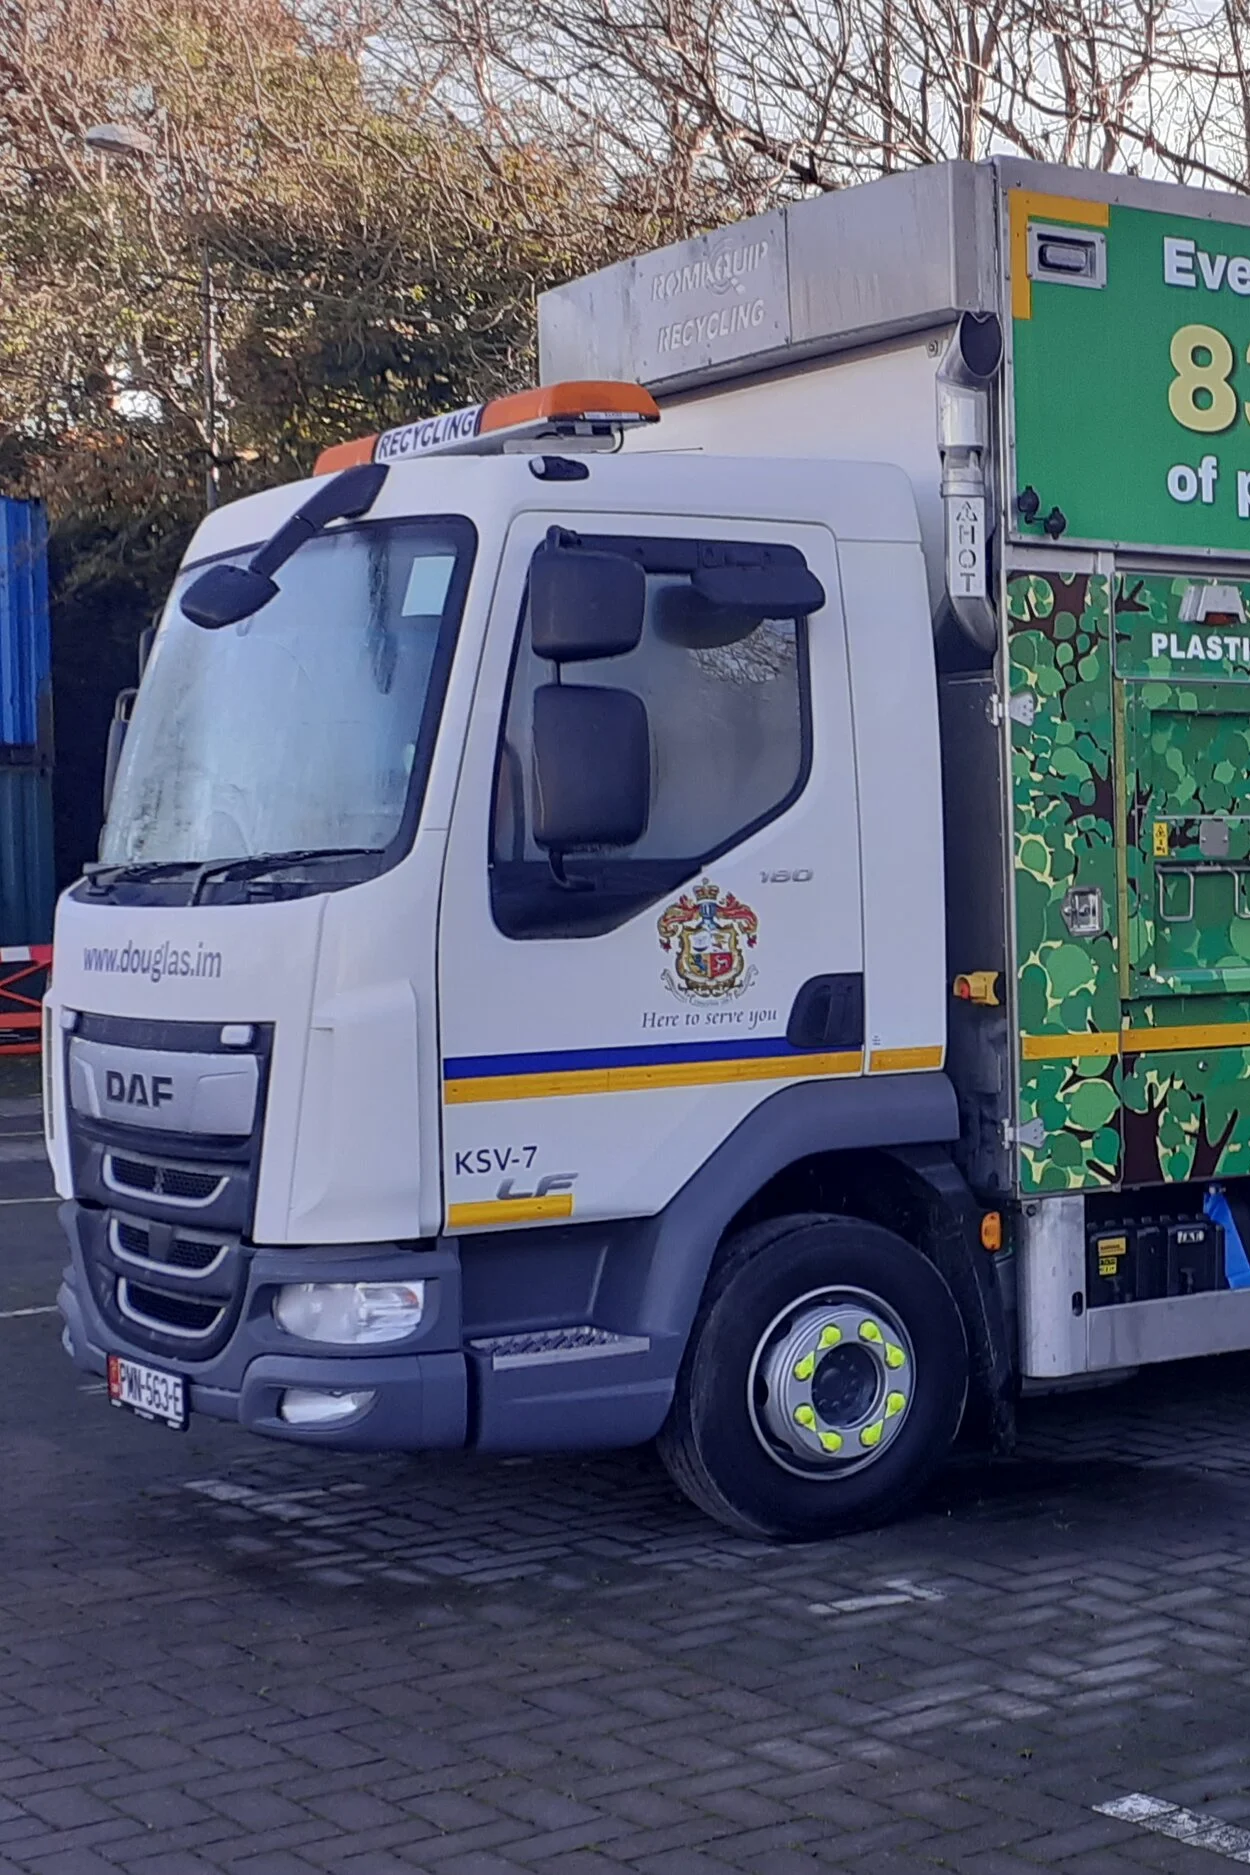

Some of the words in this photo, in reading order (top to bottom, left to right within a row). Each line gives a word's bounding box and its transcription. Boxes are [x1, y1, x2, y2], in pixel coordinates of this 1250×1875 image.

[658, 299, 765, 353] RECYCLING
[379, 410, 476, 459] RECYCLING
[1166, 456, 1218, 504] of
[760, 868, 814, 884] 180
[83, 939, 223, 984] www.douglas.im
[642, 1012, 679, 1029] Here
[685, 1012, 700, 1026] to
[705, 1009, 744, 1025] serve
[748, 1009, 778, 1030] you
[106, 1069, 174, 1108] DAF
[455, 1145, 538, 1175] KSV-7
[496, 1172, 580, 1200] LF
